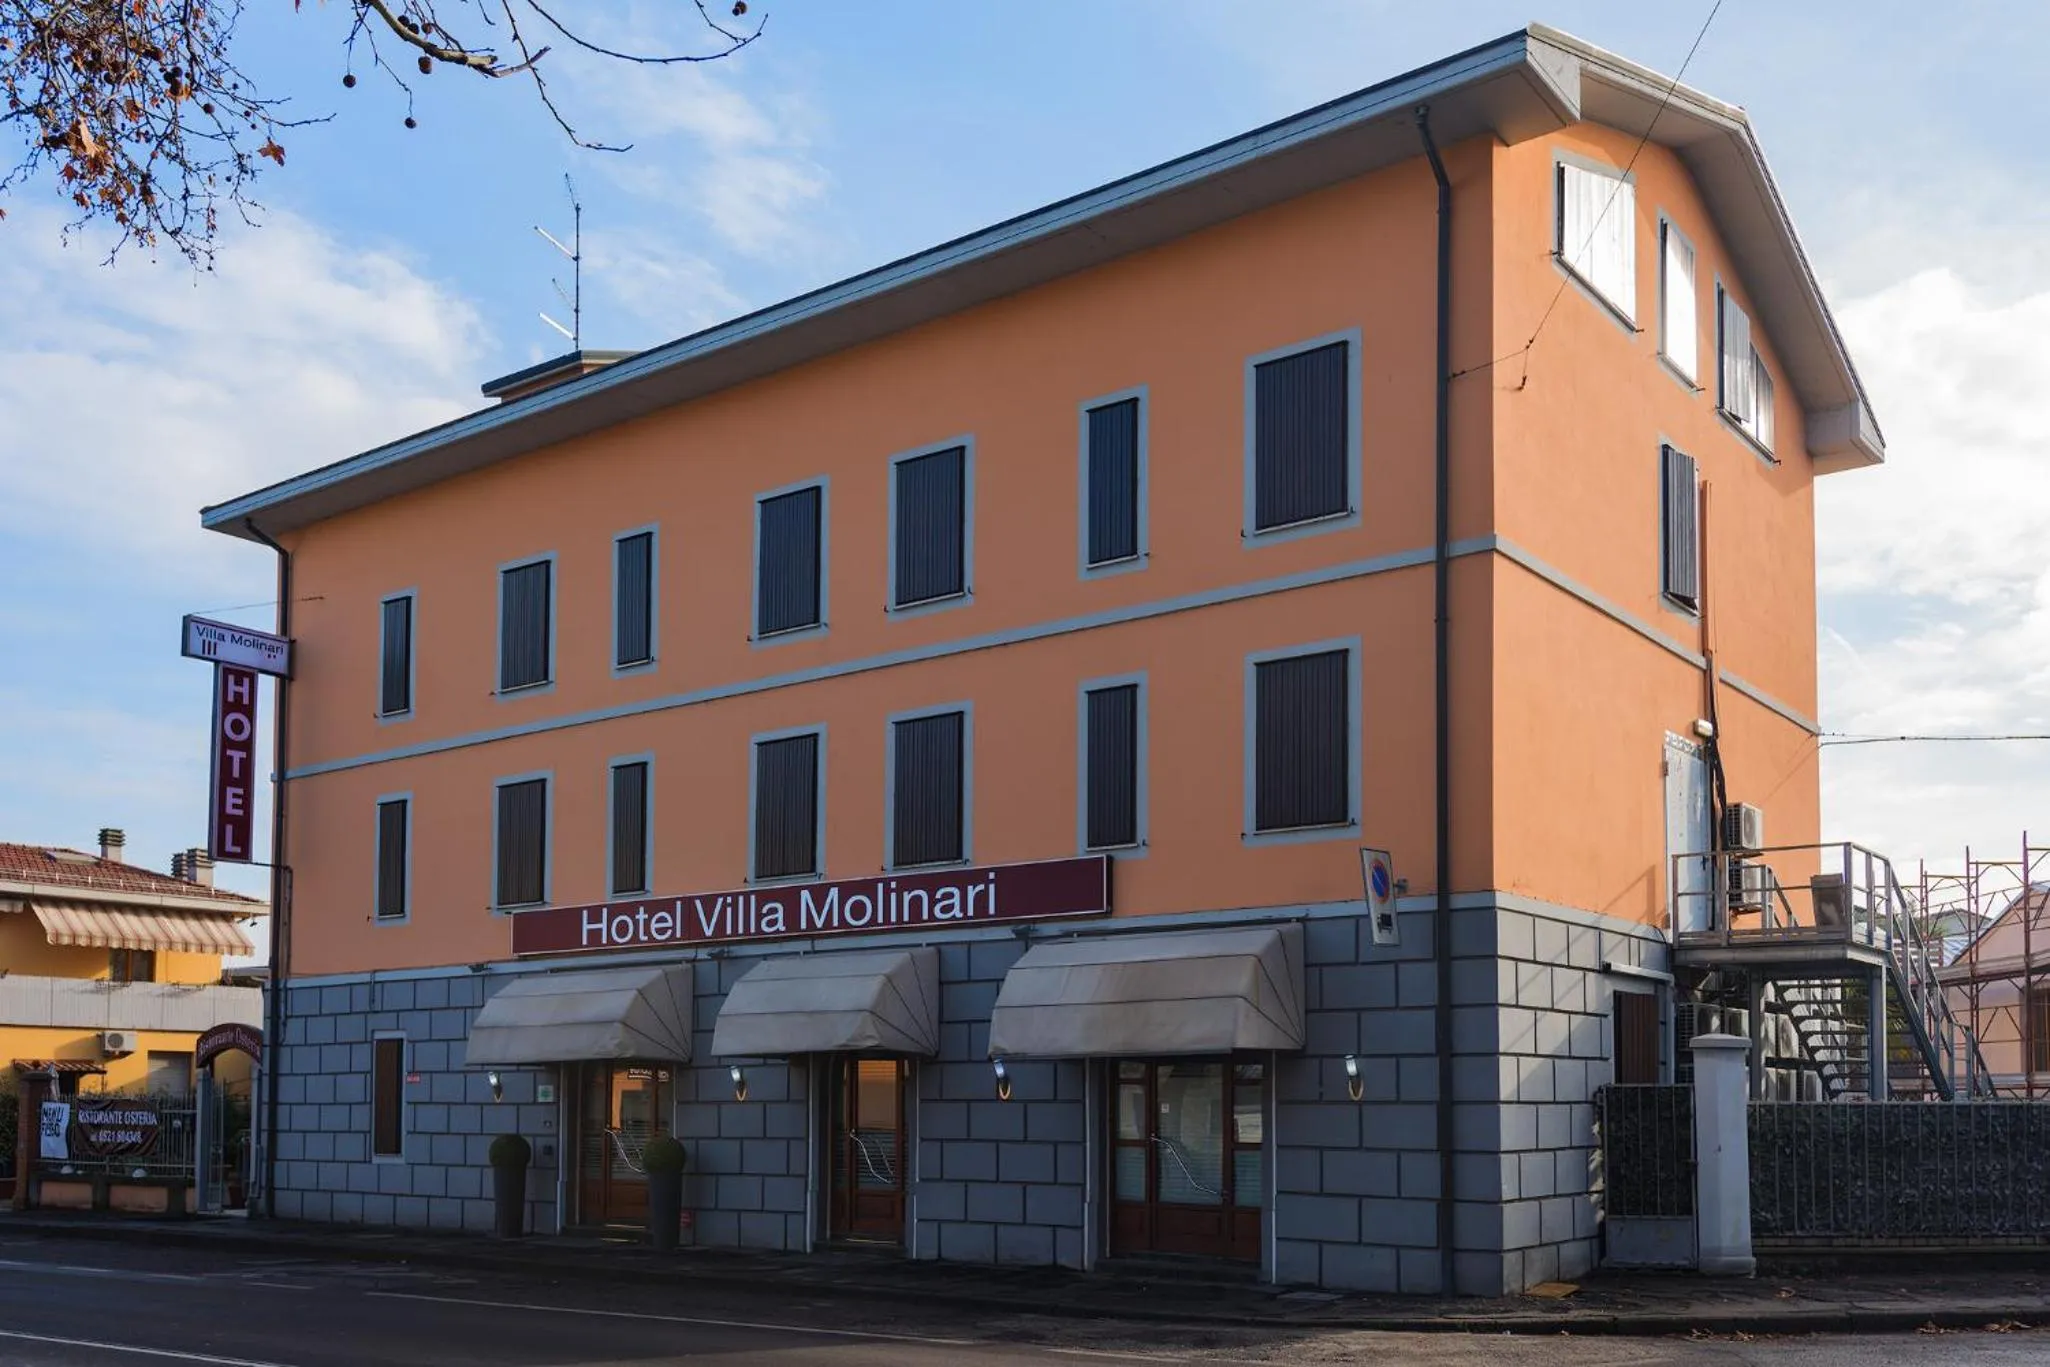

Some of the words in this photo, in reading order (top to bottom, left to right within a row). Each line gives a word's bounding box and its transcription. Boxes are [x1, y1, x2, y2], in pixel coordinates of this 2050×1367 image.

[196, 625, 225, 642] Villa
[230, 633, 284, 655] Molinari
[224, 674, 251, 853] HOTEL
[581, 900, 682, 945] Hotel
[695, 894, 786, 937] Villa
[800, 871, 996, 930] Molinari
[78, 1110, 122, 1124] RISTORANTE
[124, 1110, 158, 1125] OSTERIA
